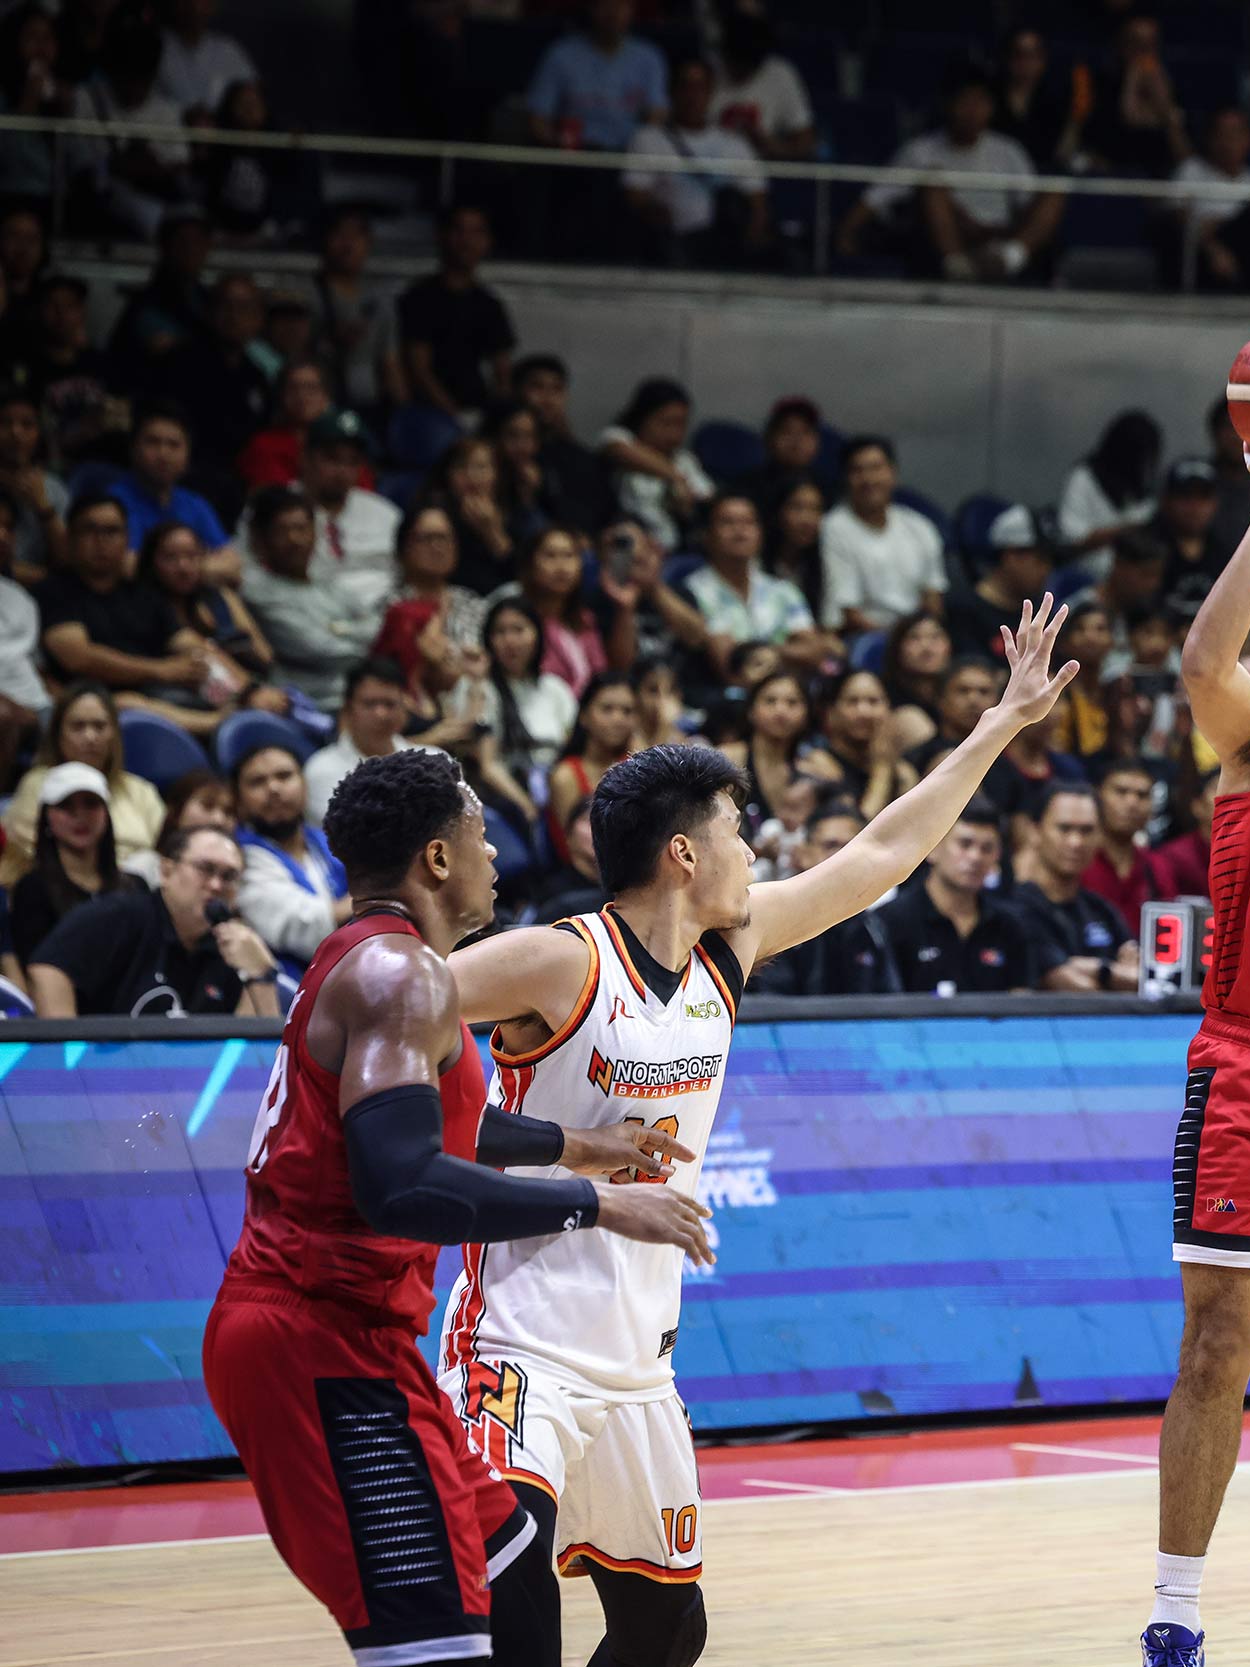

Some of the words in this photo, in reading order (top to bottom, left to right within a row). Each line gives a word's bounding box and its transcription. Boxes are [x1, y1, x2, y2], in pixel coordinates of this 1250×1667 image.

[1155, 914, 1183, 966] 3
[613, 1054, 723, 1086] NORTHPORT
[661, 1503, 698, 1557] 10
